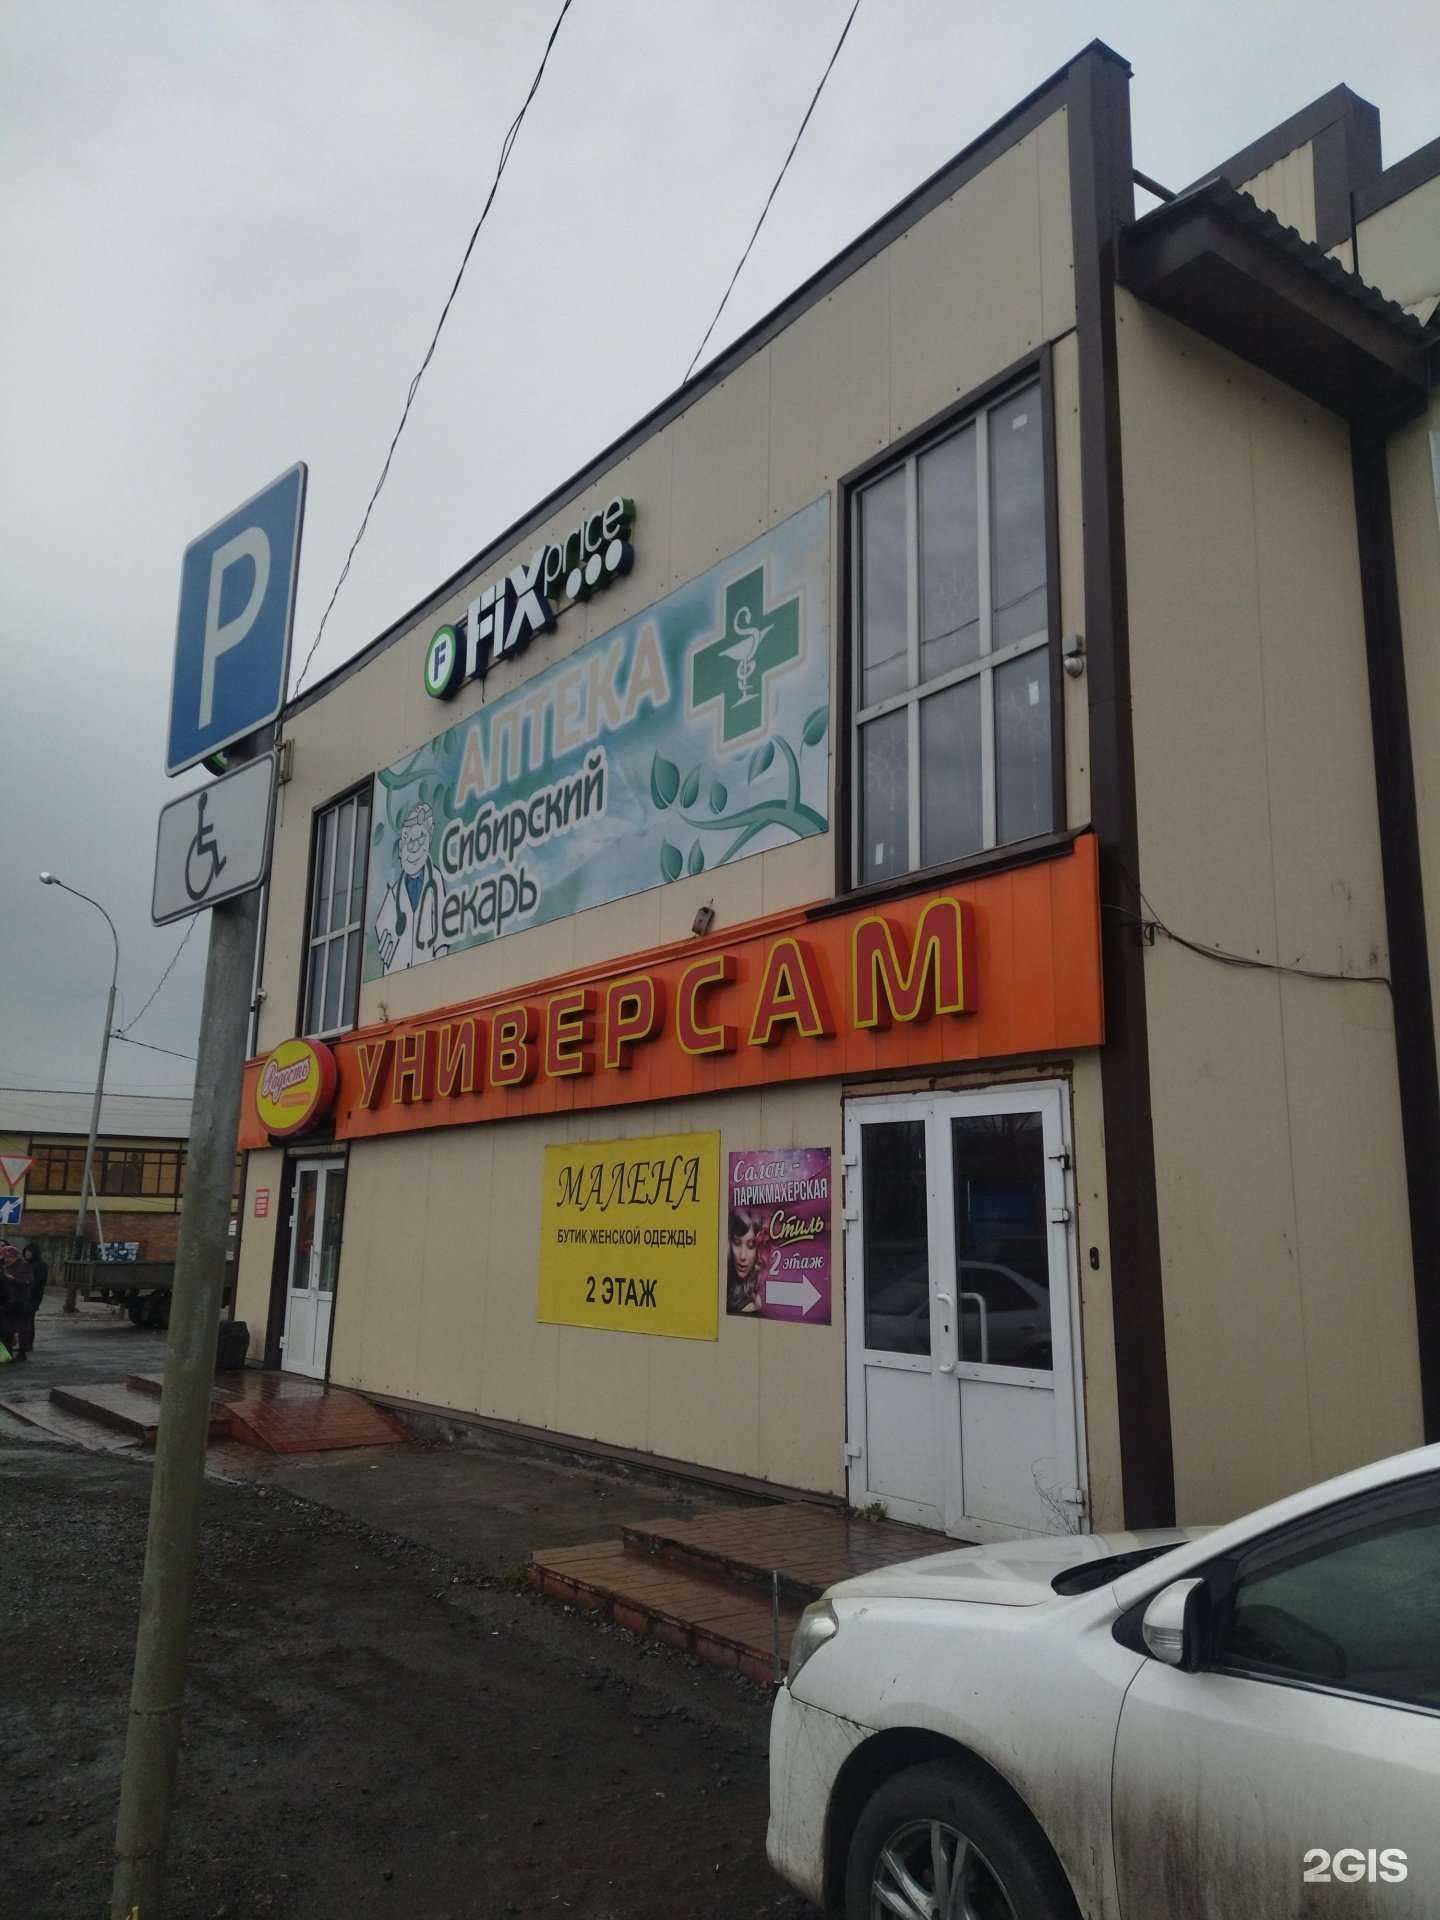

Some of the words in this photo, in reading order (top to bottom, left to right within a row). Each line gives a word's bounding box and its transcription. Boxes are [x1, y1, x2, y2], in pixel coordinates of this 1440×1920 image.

[544, 496, 624, 597] price
[198, 526, 271, 730] P
[457, 625, 669, 804] АПТЕКА
[442, 756, 604, 874] Сибирский
[416, 867, 538, 950] Лекарь
[357, 897, 970, 1109] УНИВЕРСАМ
[556, 1155, 701, 1212] МАЛЕНА
[733, 1179, 828, 1206] ПАРИКМАХЕРСКАЯ
[734, 1160, 785, 1183] Салон
[557, 1229, 588, 1244] БУТИК
[589, 1226, 640, 1245] ЖЕНСКОЙ
[644, 1230, 696, 1247] ОДЕЖДЫ
[769, 1209, 824, 1240] Стиль
[769, 1250, 781, 1275] 2
[783, 1252, 824, 1269] этаж
[585, 1276, 596, 1302] 2
[601, 1277, 657, 1307] ЭТАЖ
